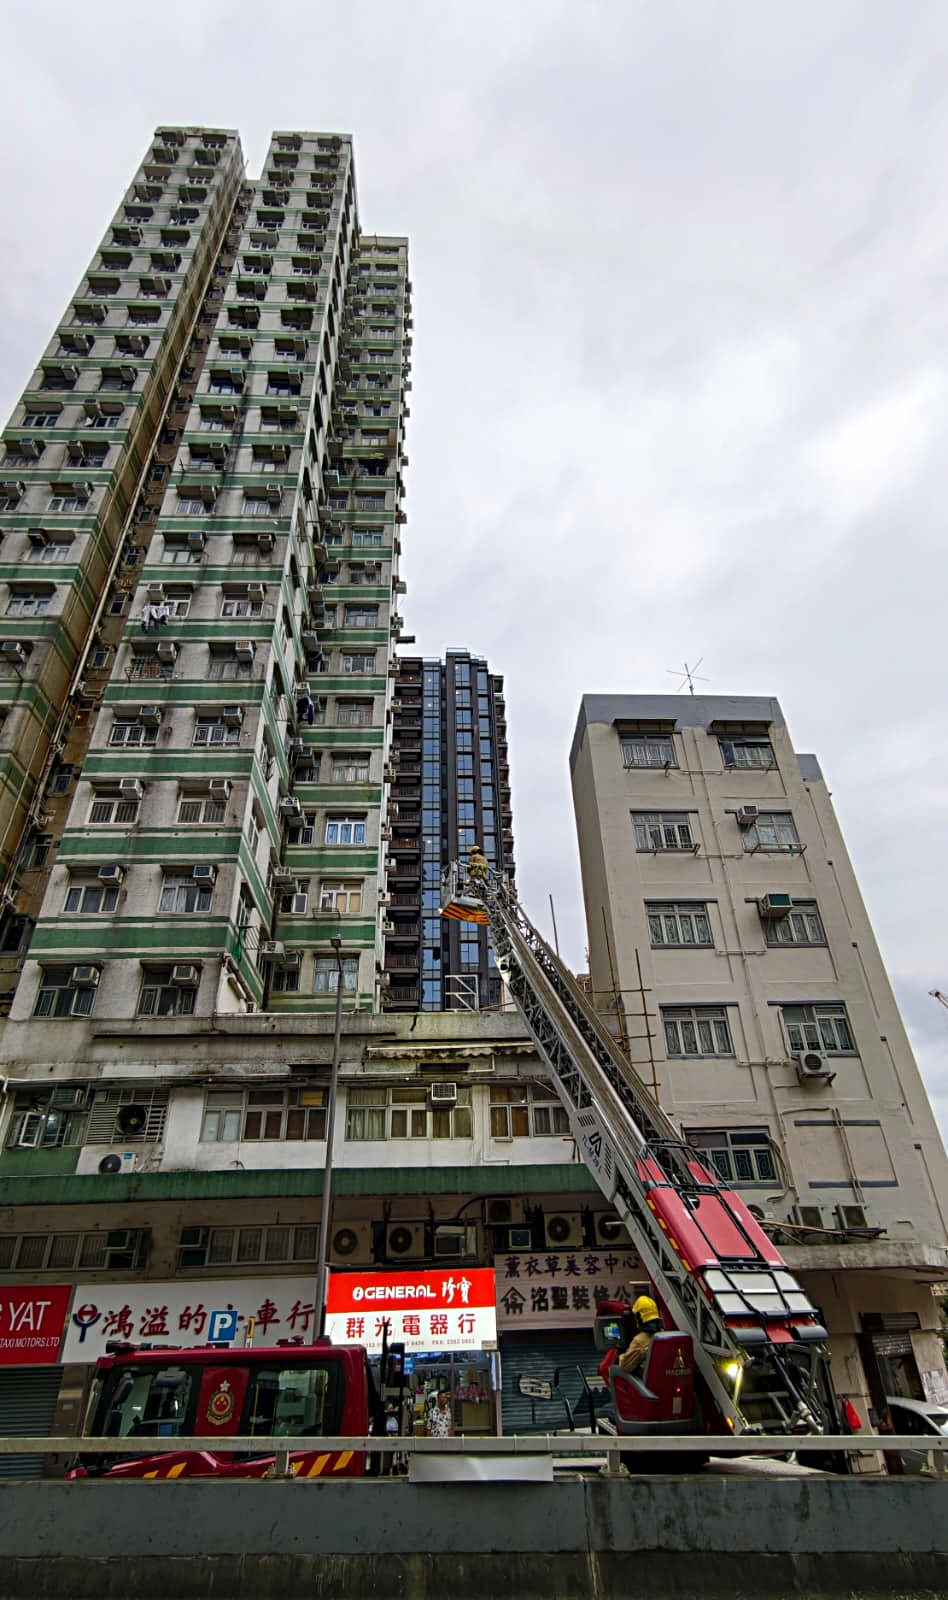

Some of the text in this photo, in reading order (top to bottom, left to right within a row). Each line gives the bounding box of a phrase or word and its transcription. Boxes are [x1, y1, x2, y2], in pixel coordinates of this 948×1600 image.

[441, 1276, 472, 1304] 珍寶
[8, 1301, 51, 1331] YAT
[212, 1312, 233, 1339] P
[346, 1313, 476, 1339] 群光電器行
[15, 1336, 46, 1348] MOTORS
[46, 1336, 60, 1347] LTD
